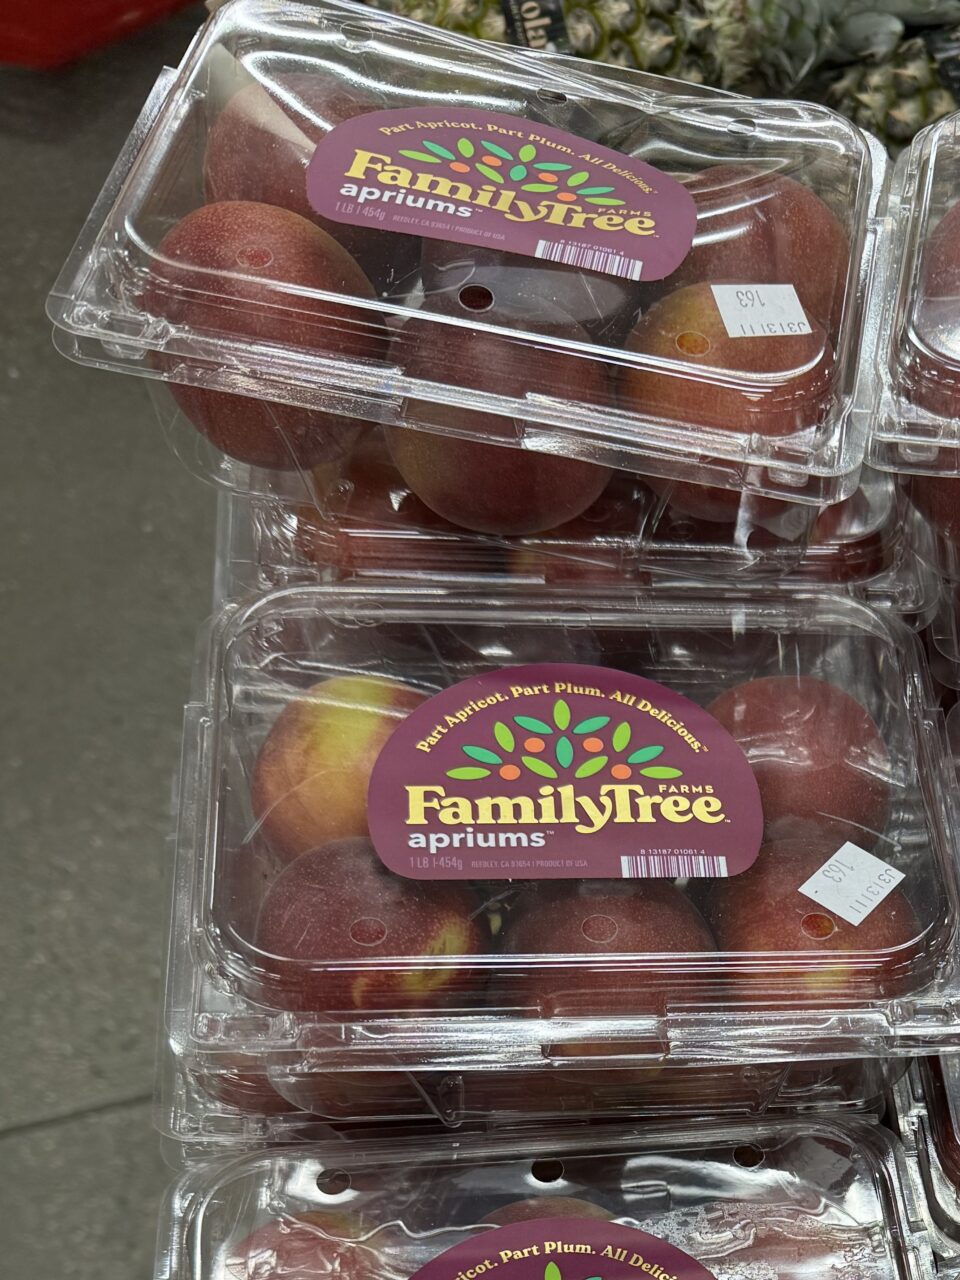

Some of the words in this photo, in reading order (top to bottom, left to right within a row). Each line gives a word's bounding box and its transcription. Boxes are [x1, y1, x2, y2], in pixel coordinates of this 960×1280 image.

[379, 121, 414, 136] Part
[416, 120, 483, 132] Apricot.
[487, 124, 524, 139] Part
[529, 134, 574, 155] Plum.
[579, 152, 604, 166] All
[601, 160, 654, 194] Delicious.
[339, 181, 472, 218] apriums
[343, 149, 656, 236] FamilyTree
[598, 207, 652, 217] FARMS
[736, 290, 765, 308] 163
[416, 727, 448, 753] Part
[445, 693, 509, 730] Apricot.
[512, 684, 550, 698] Part
[555, 682, 605, 697] Plum.
[609, 692, 636, 710] All
[638, 699, 701, 753] Delicious.
[659, 784, 713, 793] FARMS
[405, 784, 725, 833] FamilyTree
[408, 827, 545, 853] apriums
[822, 859, 854, 883] 163
[499, 1245, 540, 1263] Part
[544, 1241, 595, 1254] Plum.
[600, 1245, 627, 1262] All
